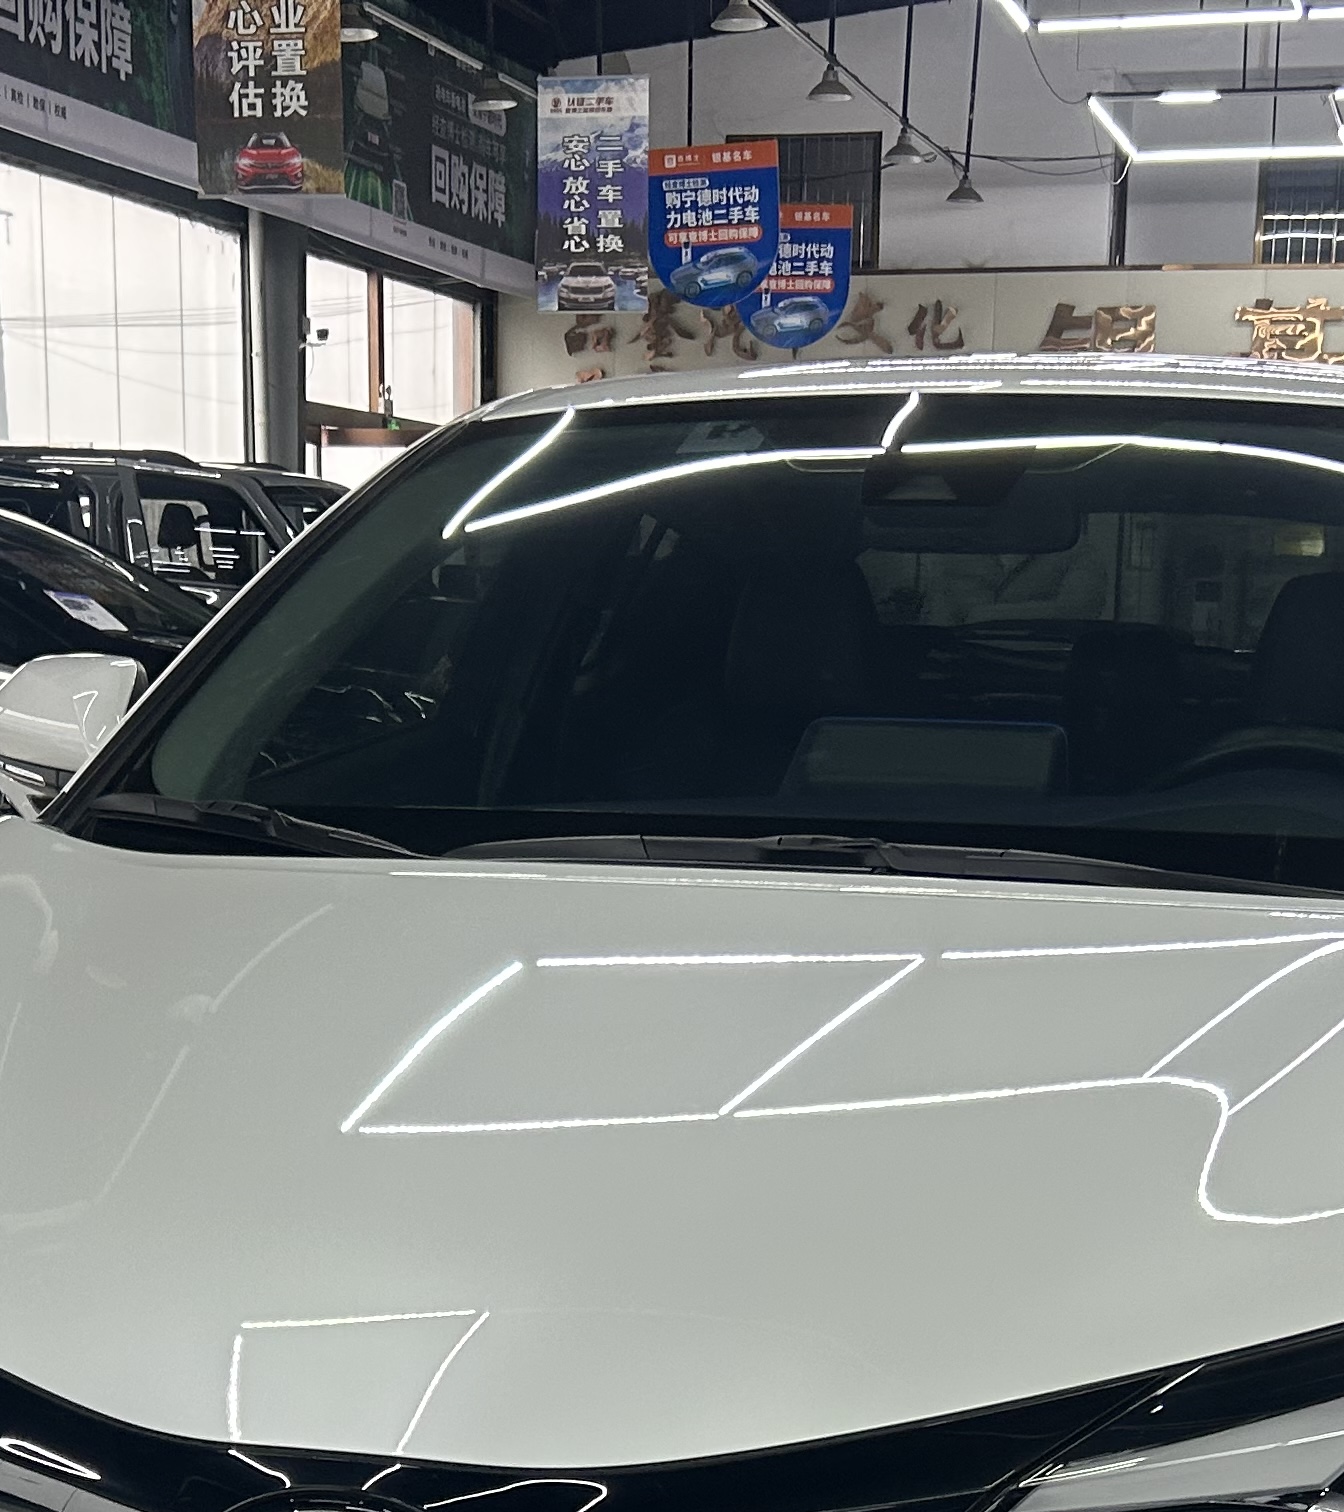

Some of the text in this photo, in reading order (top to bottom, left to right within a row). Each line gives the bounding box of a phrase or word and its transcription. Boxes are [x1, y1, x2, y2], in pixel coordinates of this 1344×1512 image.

[227, 0, 265, 118] 心评估
[269, 0, 309, 117] 业置换
[431, 144, 506, 228] 回购保障
[562, 134, 591, 253] 安心放心省心
[596, 136, 624, 253] 二手车置换
[665, 185, 759, 209] 购宁德时代动
[711, 150, 752, 163] 银基名车
[666, 205, 760, 229] 力电池二手车
